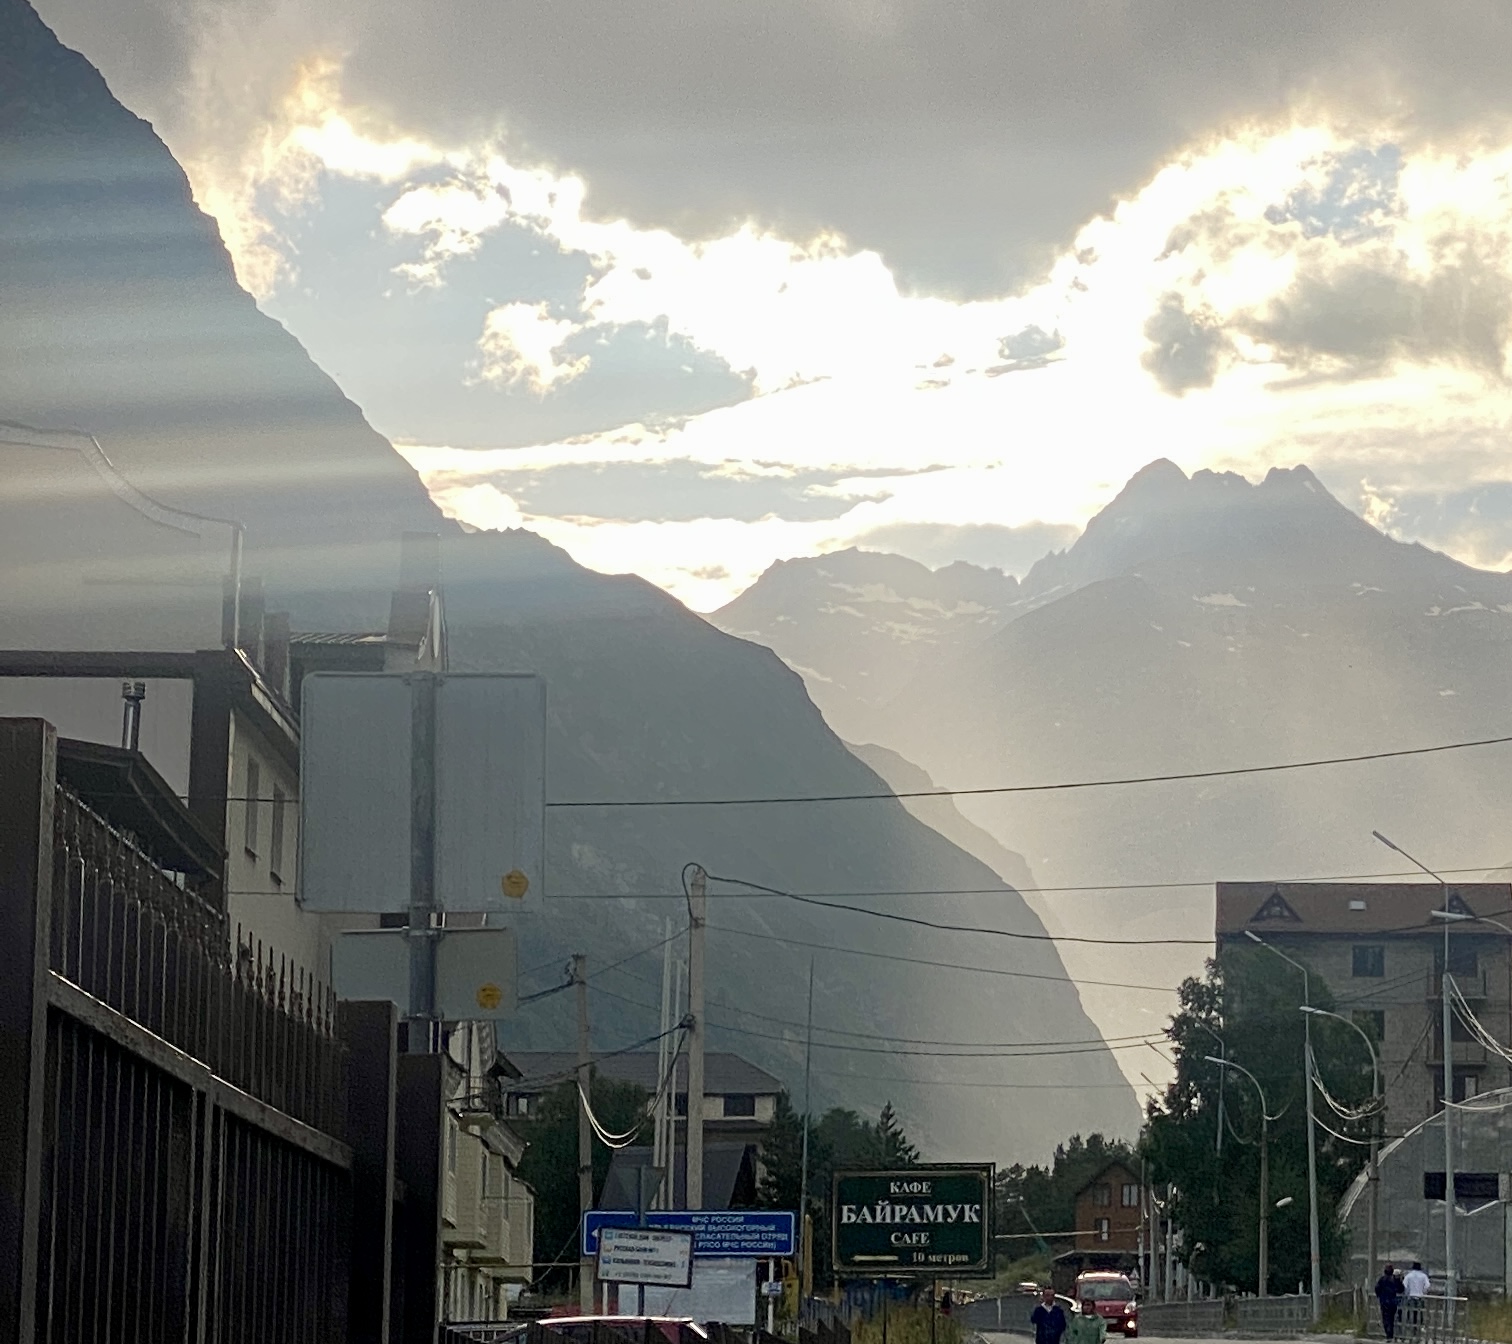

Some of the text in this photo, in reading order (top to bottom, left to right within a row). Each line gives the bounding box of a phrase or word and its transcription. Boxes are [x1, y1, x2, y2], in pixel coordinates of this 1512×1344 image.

[890, 1181, 932, 1194] КАФЕ
[840, 1199, 981, 1224] БАЙРАМУК
[890, 1232, 930, 1244] CAFE
[912, 1252, 969, 1265] 10 метров
